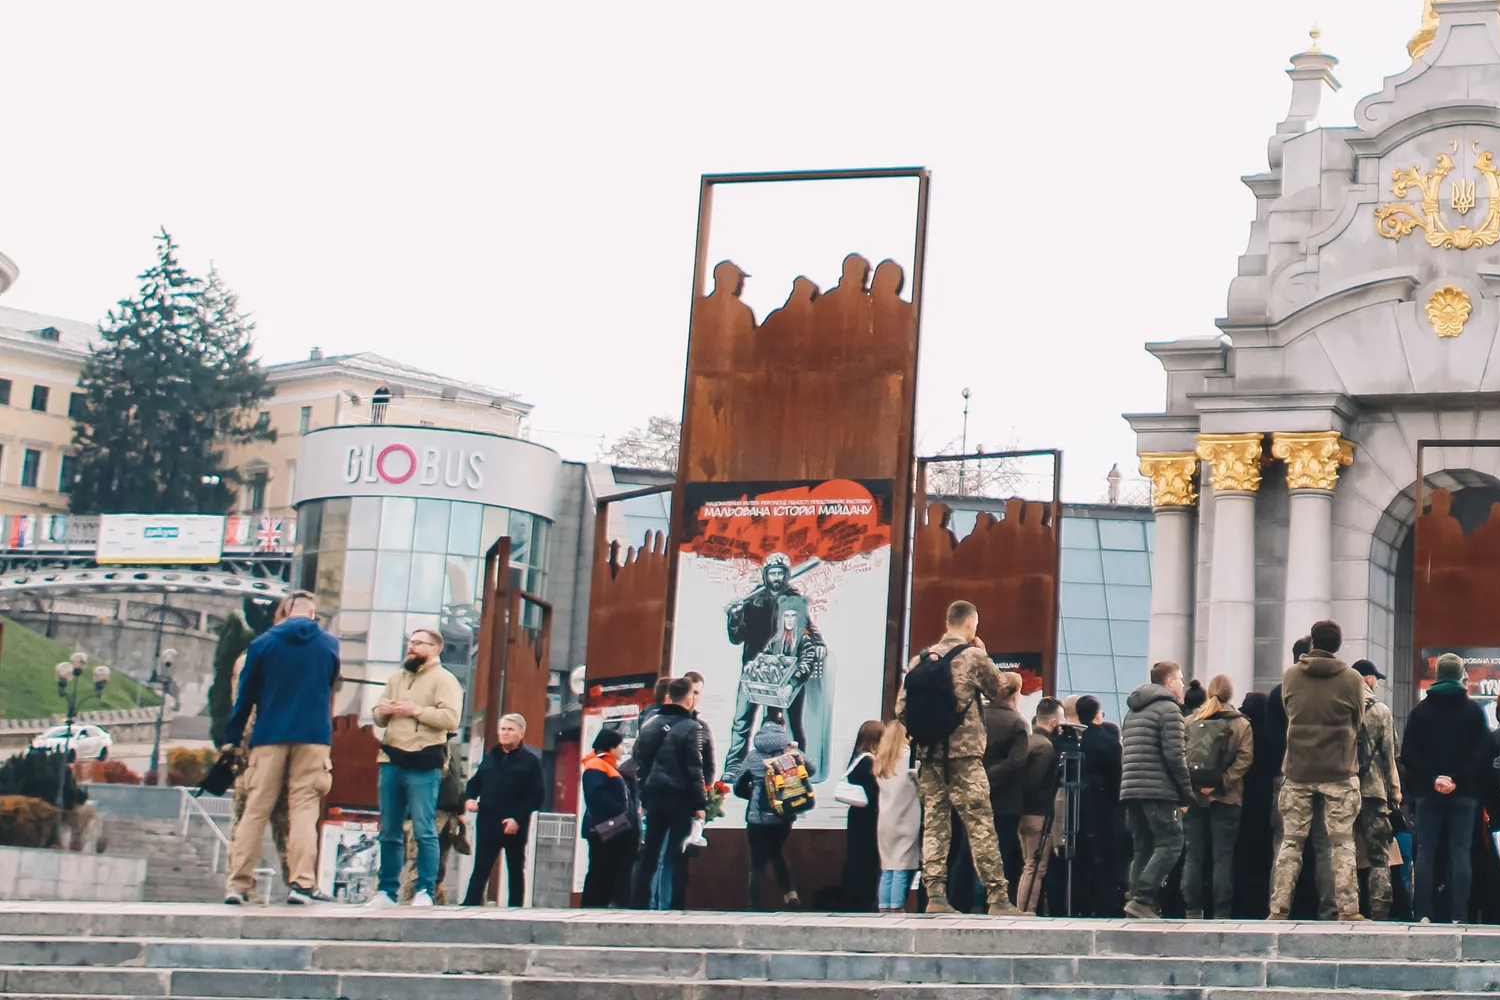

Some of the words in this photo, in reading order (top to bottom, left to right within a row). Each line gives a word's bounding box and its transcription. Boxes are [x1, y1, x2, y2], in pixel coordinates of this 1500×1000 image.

[344, 443, 484, 490] GLOBUS
[704, 506, 771, 517] МАЛЬОВАНА
[773, 505, 816, 516] ІСТОРІЯ
[818, 504, 872, 516] МАЙДАНУ
